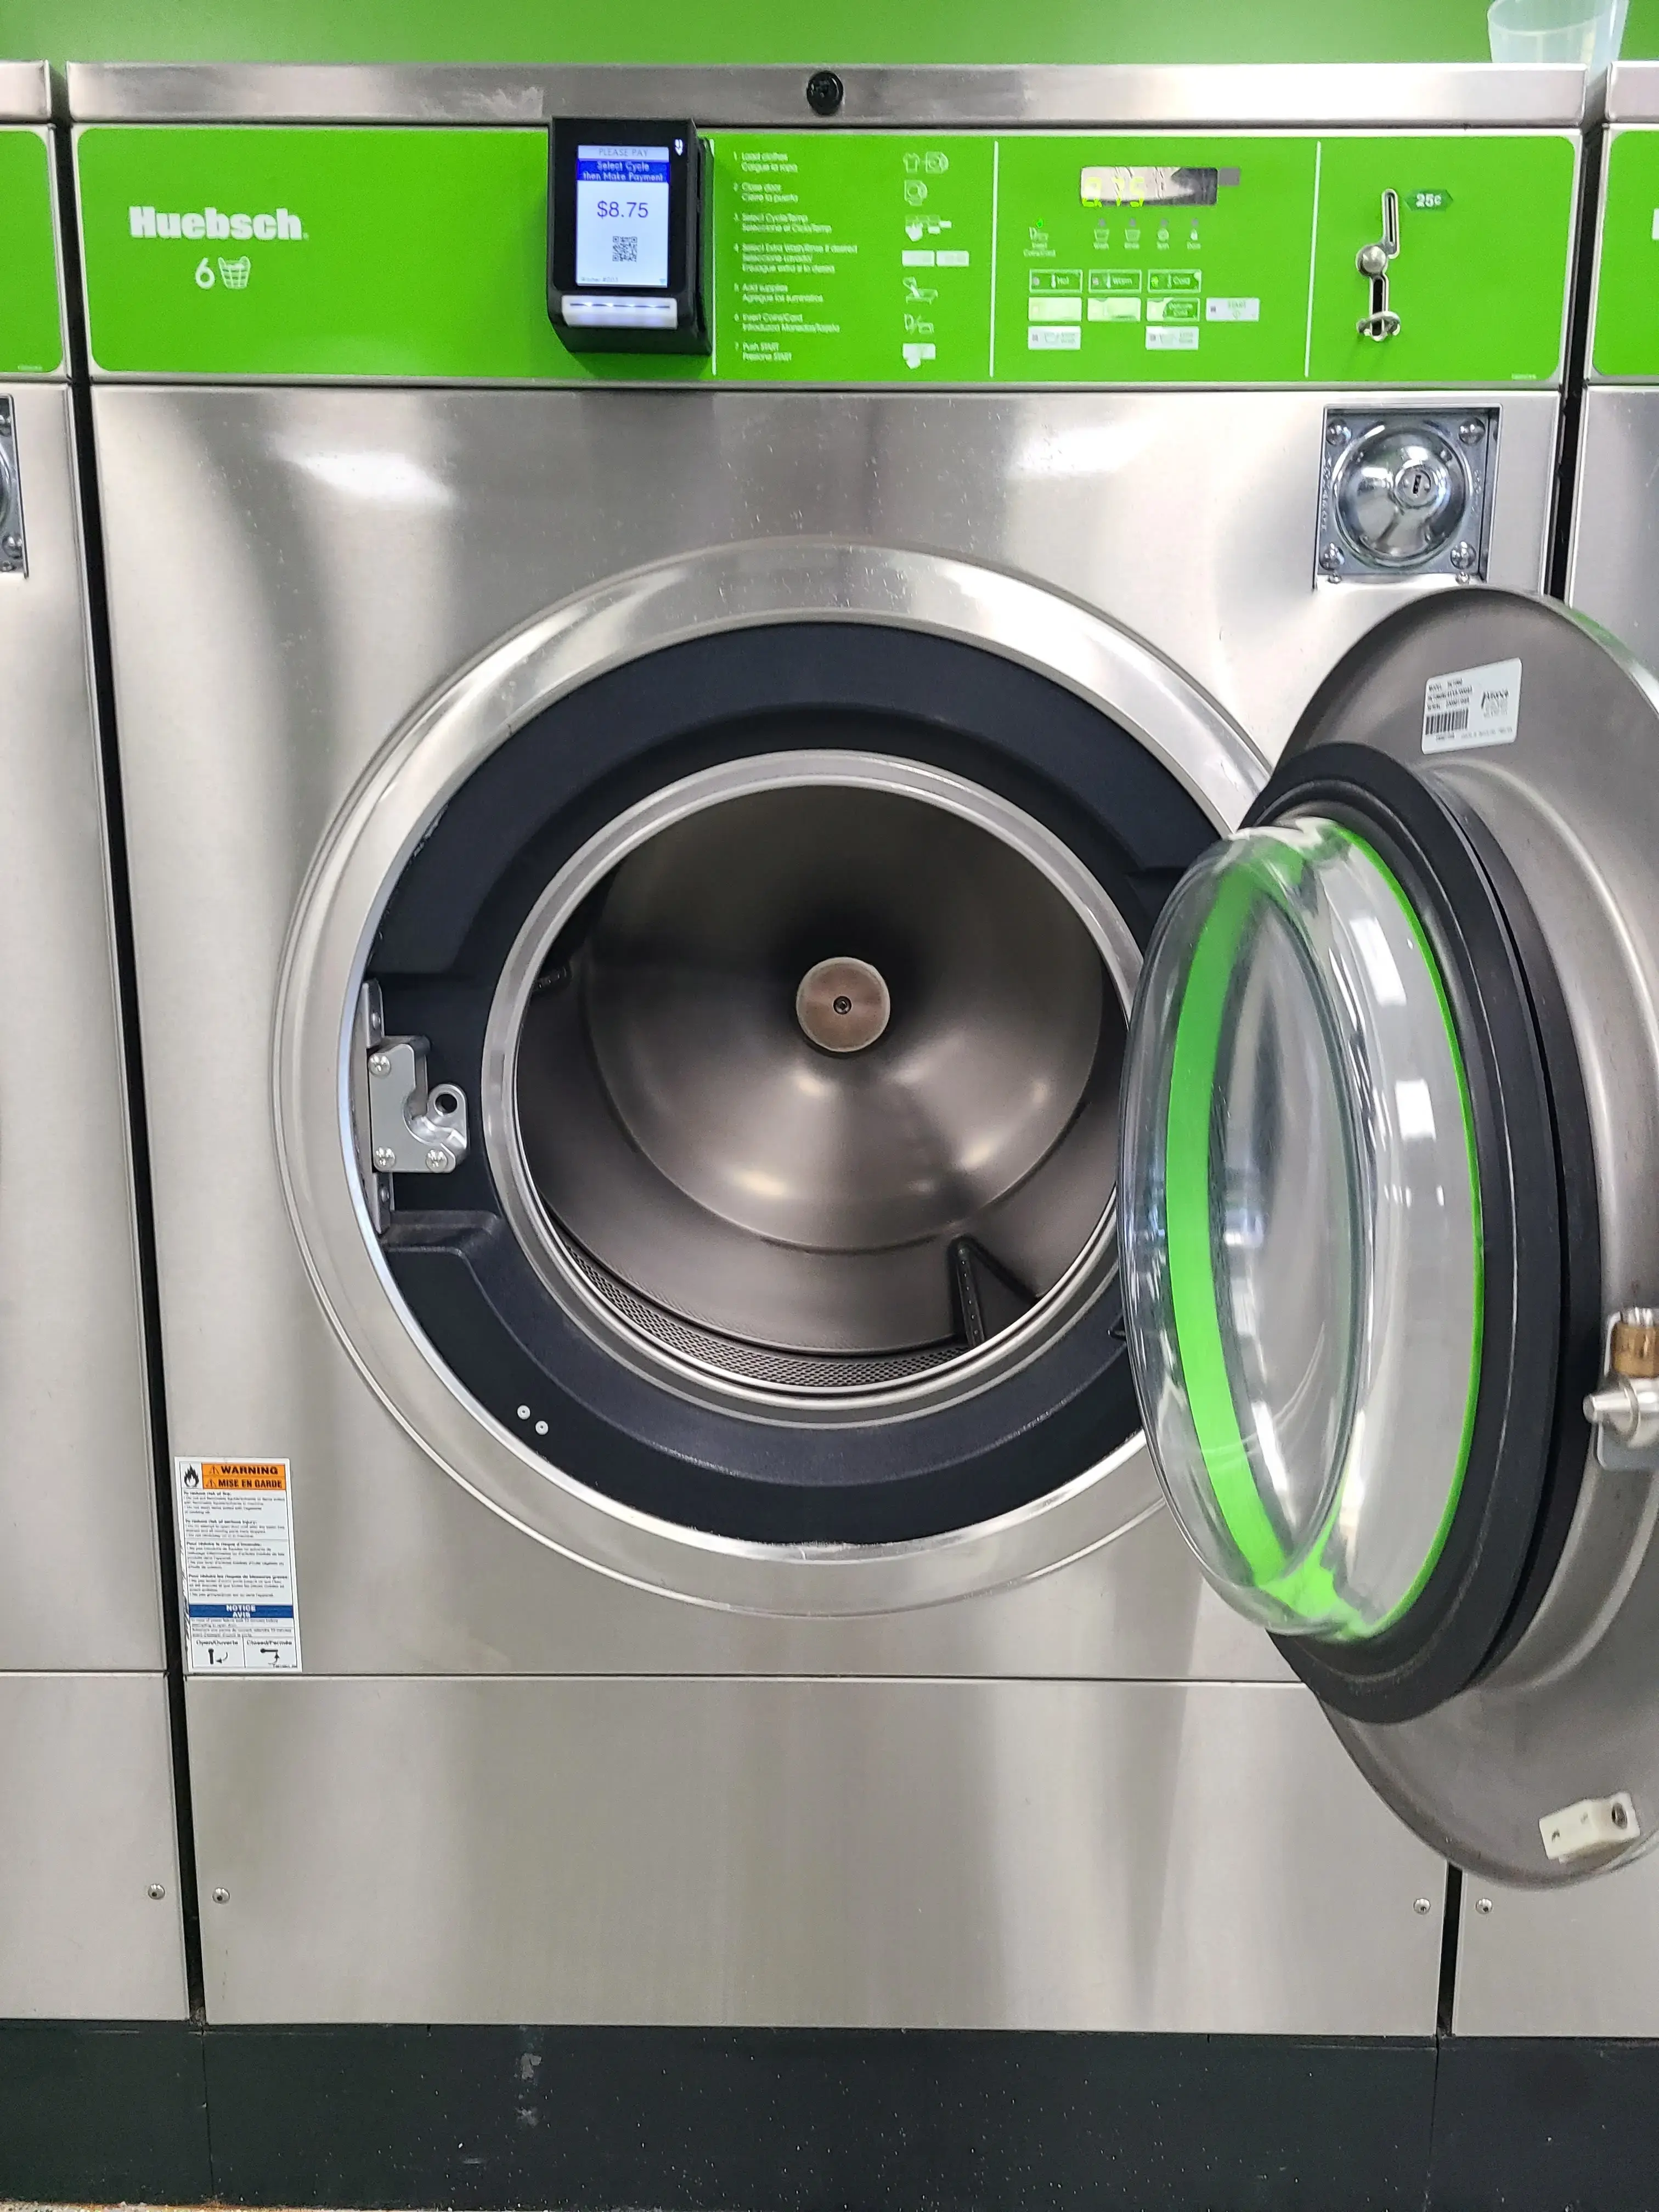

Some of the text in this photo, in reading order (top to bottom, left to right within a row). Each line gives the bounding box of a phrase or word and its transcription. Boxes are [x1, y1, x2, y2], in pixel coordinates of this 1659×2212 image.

[599, 148, 648, 157] PLEASE PAY
[597, 161, 650, 173] Select Cycle
[603, 172, 626, 181] Make
[629, 172, 663, 183] Payment
[597, 200, 649, 219] $8.75
[129, 205, 302, 240] Huebsch
[195, 257, 216, 290] 6
[221, 1465, 279, 1475] WARNING
[218, 1479, 283, 1488] MISE EN GARDE
